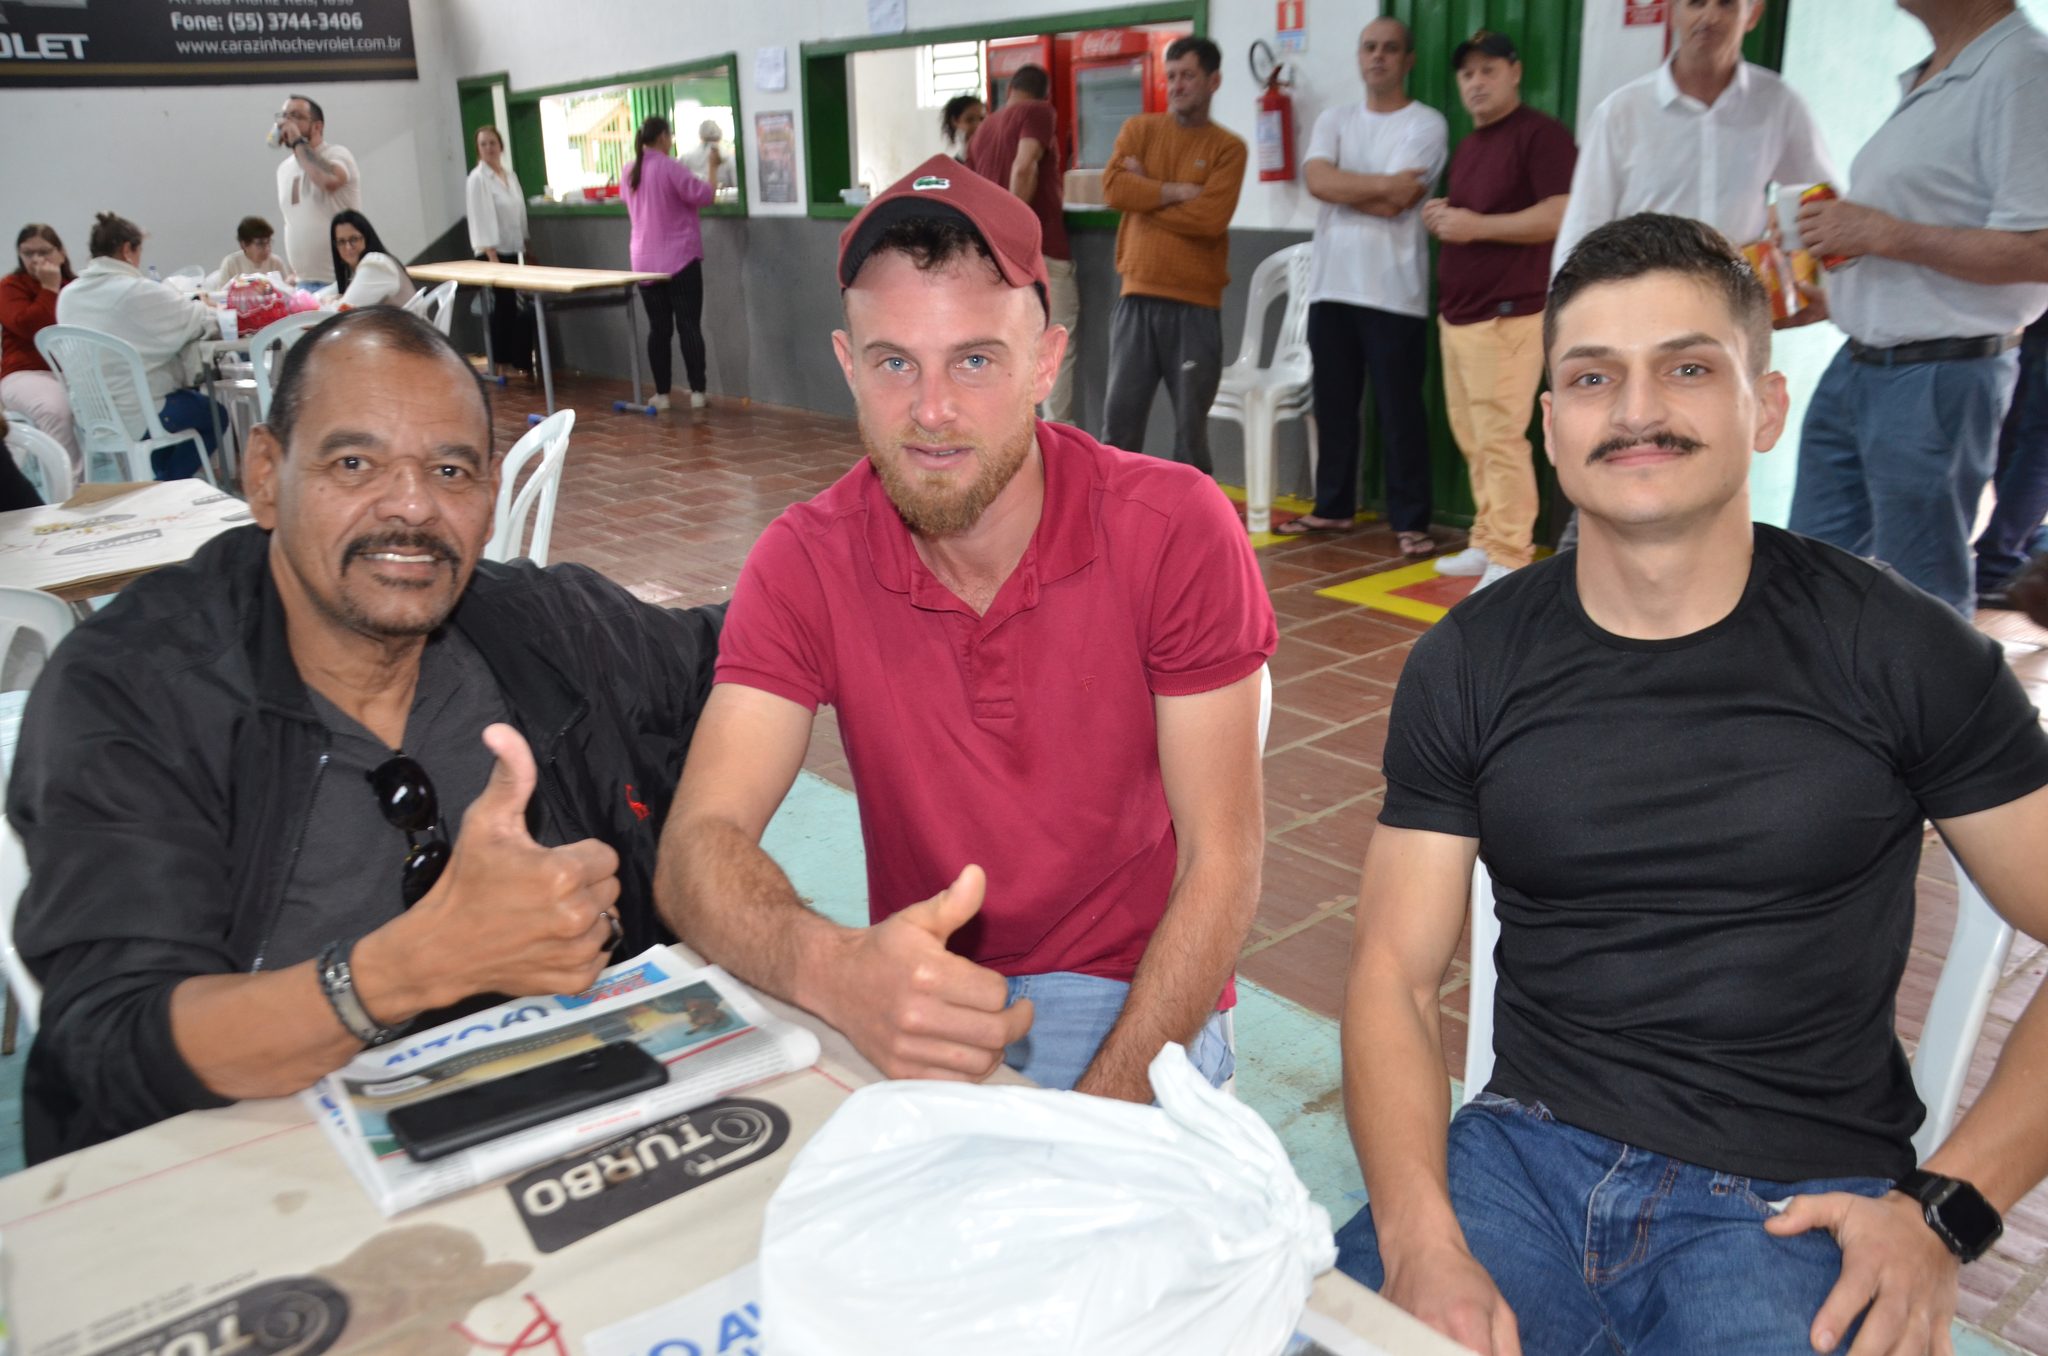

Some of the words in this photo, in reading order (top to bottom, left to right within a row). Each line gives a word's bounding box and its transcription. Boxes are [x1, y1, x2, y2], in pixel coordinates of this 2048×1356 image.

[170, 11, 223, 31] Fone:
[228, 11, 264, 33] (55)
[267, 11, 363, 31] 3744-3406
[175, 35, 402, 54] www.carazinhochevrolet.com.br
[521, 1121, 715, 1217] TURBO
